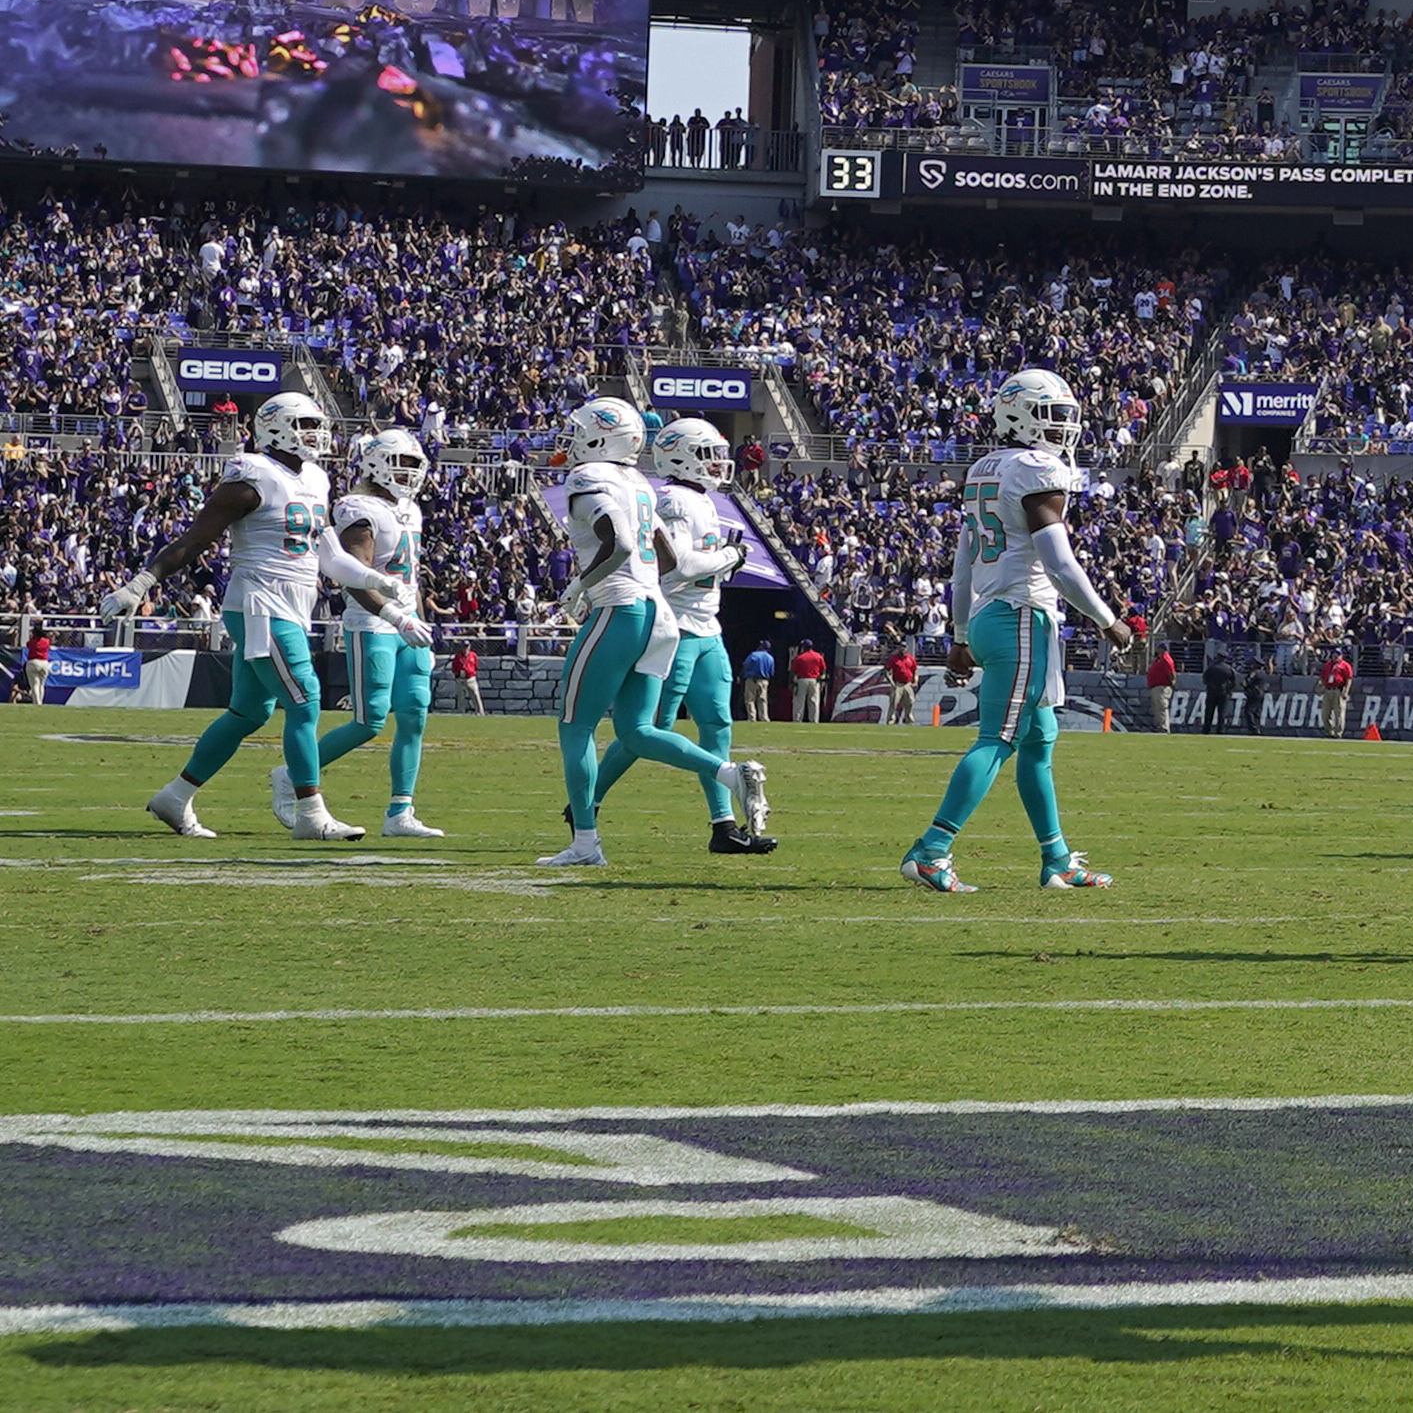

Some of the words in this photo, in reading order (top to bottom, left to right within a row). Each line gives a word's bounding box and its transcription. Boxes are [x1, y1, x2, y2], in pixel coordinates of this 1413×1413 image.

[979, 78, 1038, 90] SPORTSBOOK
[980, 70, 1015, 79] CAESARS
[1317, 79, 1351, 87] CAESARS
[832, 157, 873, 191] 33
[954, 171, 1079, 191] SOCIOS.com
[1095, 163, 1172, 181] LAMARR
[1175, 164, 1275, 182] JACKSON'S
[1279, 167, 1327, 183] PASS
[1094, 181, 1113, 197] IN
[1117, 182, 1153, 198] THE
[1158, 183, 1196, 199] END
[1199, 184, 1253, 200] ZONE.
[179, 358, 277, 382] GEICO
[652, 376, 748, 399] GEICO
[1256, 392, 1315, 410] merritt
[964, 482, 1008, 565] 55
[49, 660, 85, 677] CBS
[94, 661, 133, 678] NFL
